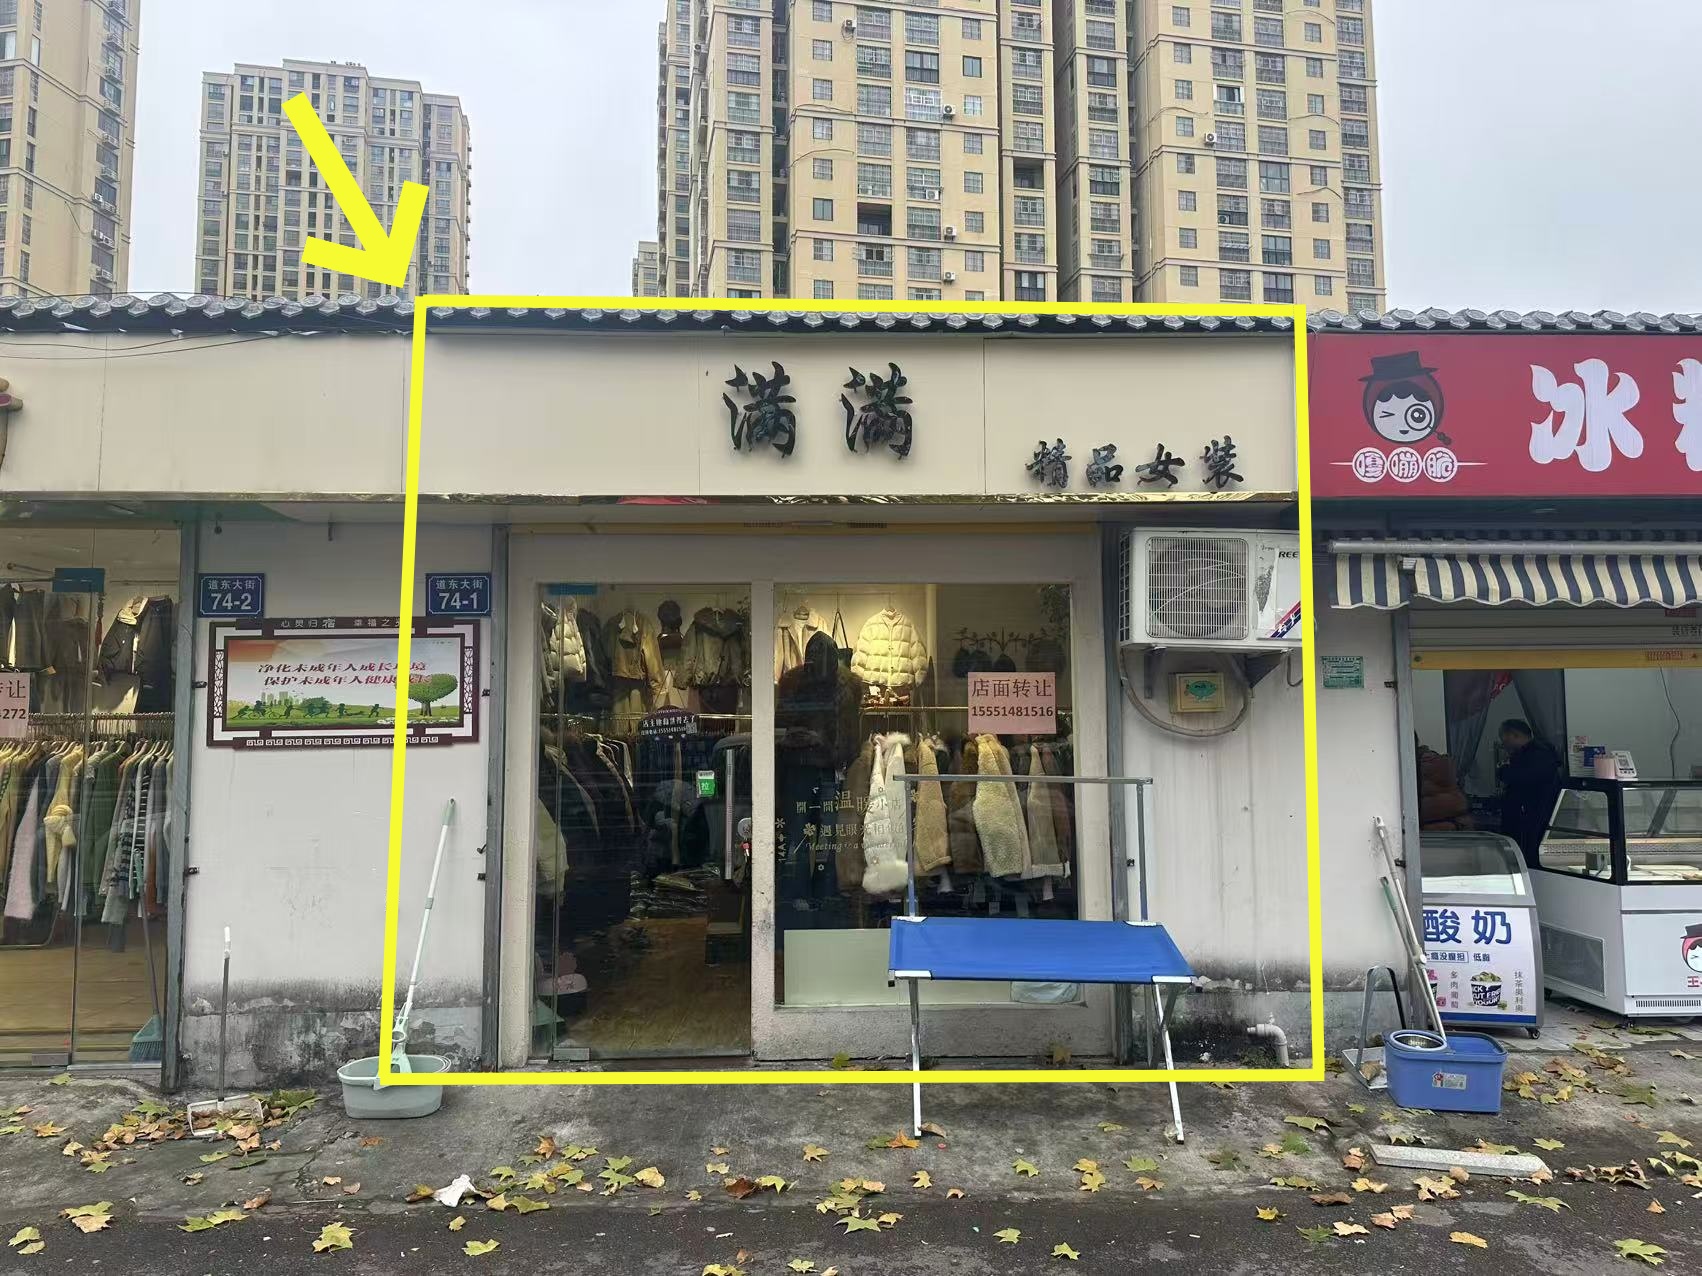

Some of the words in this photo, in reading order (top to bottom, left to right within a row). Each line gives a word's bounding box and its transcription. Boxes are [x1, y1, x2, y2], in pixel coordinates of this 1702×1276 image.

[208, 579, 256, 590] 道东大街
[436, 579, 483, 590] 道东大街
[210, 592, 253, 611] 74-2
[438, 592, 479, 610] 74-1
[257, 662, 428, 673] 净化未成年人成长境
[0, 679, 27, 699] 让
[971, 678, 1053, 698] 店面转让
[0, 708, 27, 720] 272
[971, 705, 1054, 718] 15551481516
[1422, 908, 1512, 945] 酸奶
